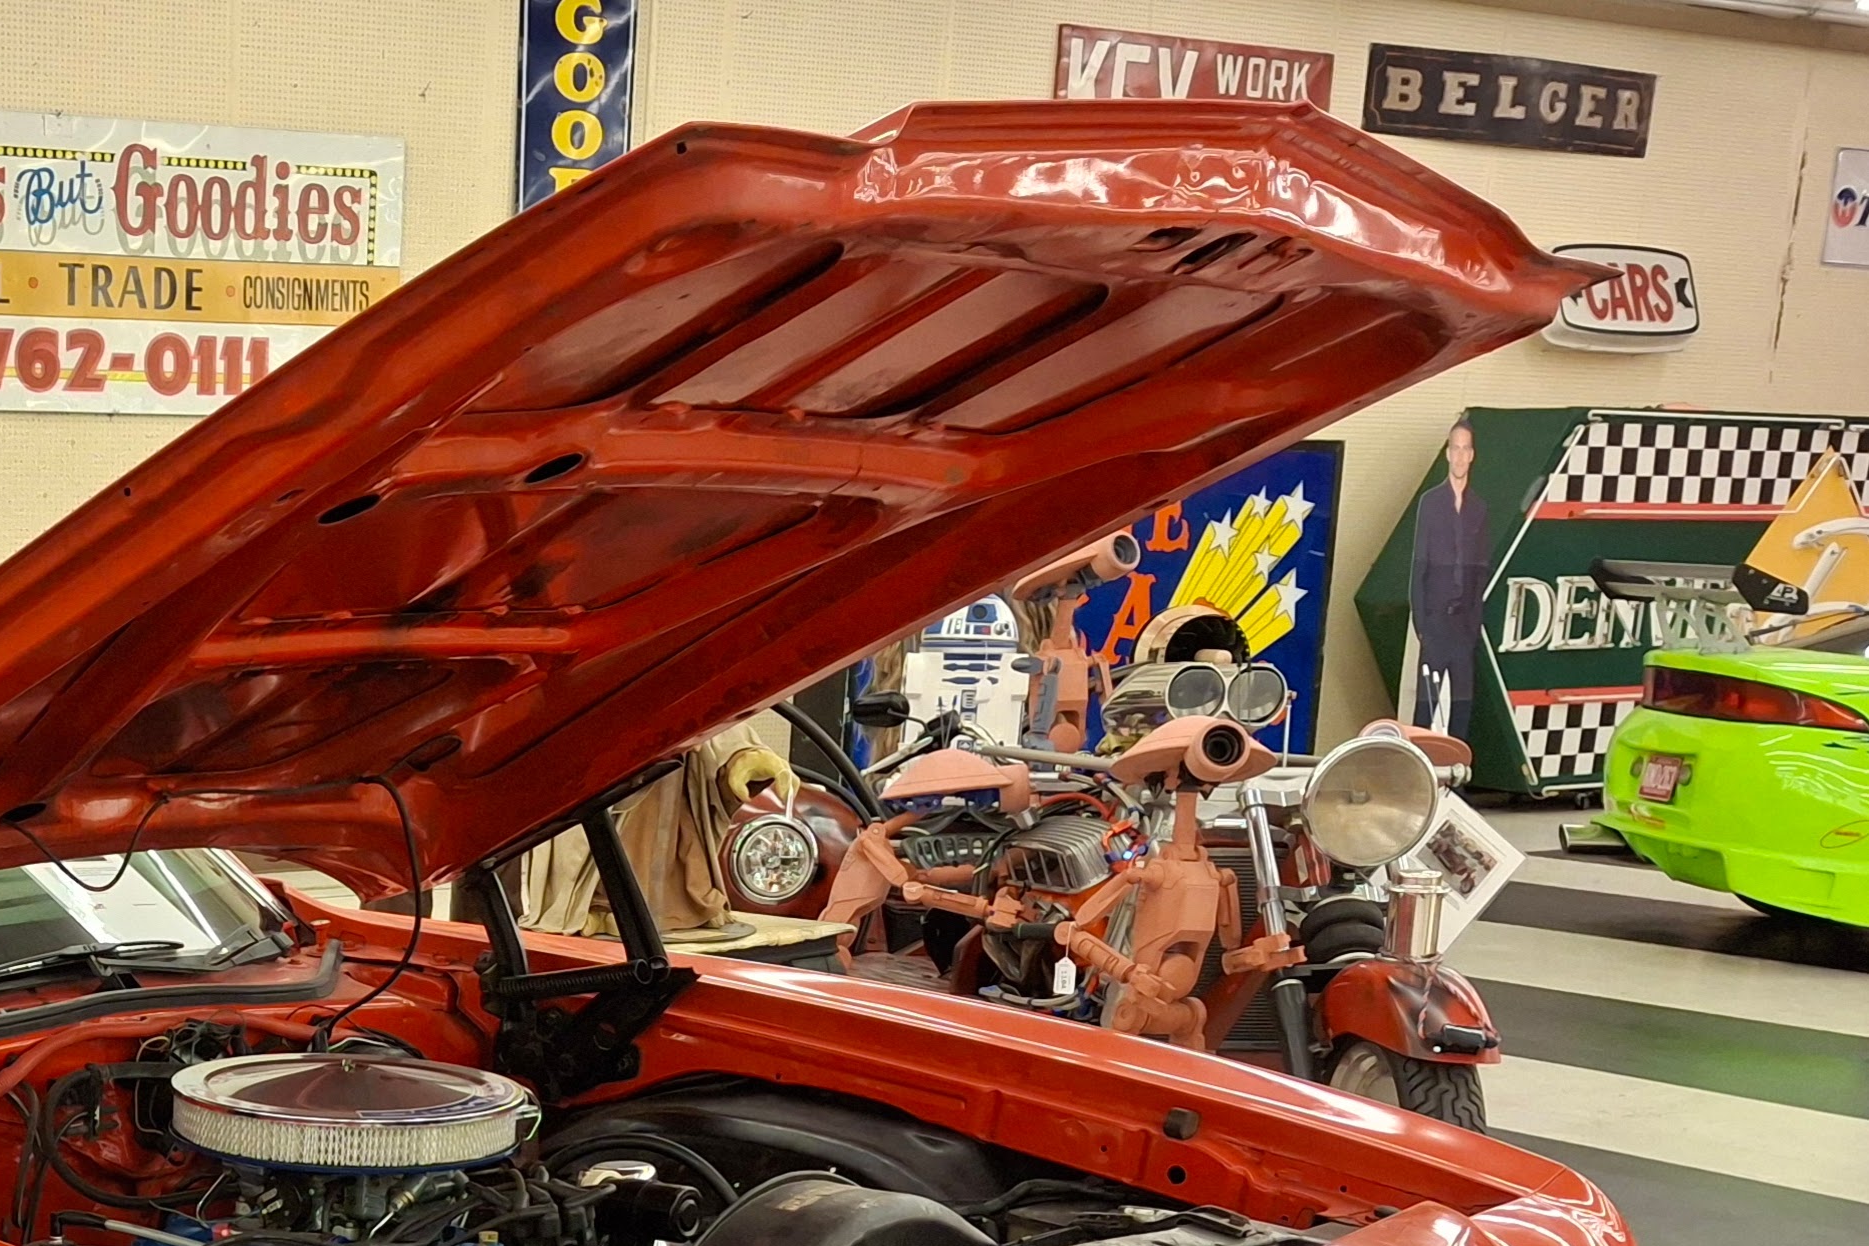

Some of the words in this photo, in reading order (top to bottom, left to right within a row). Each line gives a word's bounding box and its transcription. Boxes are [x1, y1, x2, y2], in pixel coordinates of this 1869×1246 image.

[548, 0, 607, 193] GOO
[1216, 53, 1311, 102] WORK
[1382, 65, 1641, 131] BELGER
[13, 159, 104, 226] But
[110, 143, 363, 246] Goodies
[58, 261, 204, 312] TRADE
[243, 275, 370, 313] CONSIGNMENTS
[1584, 262, 1675, 324] CARS
